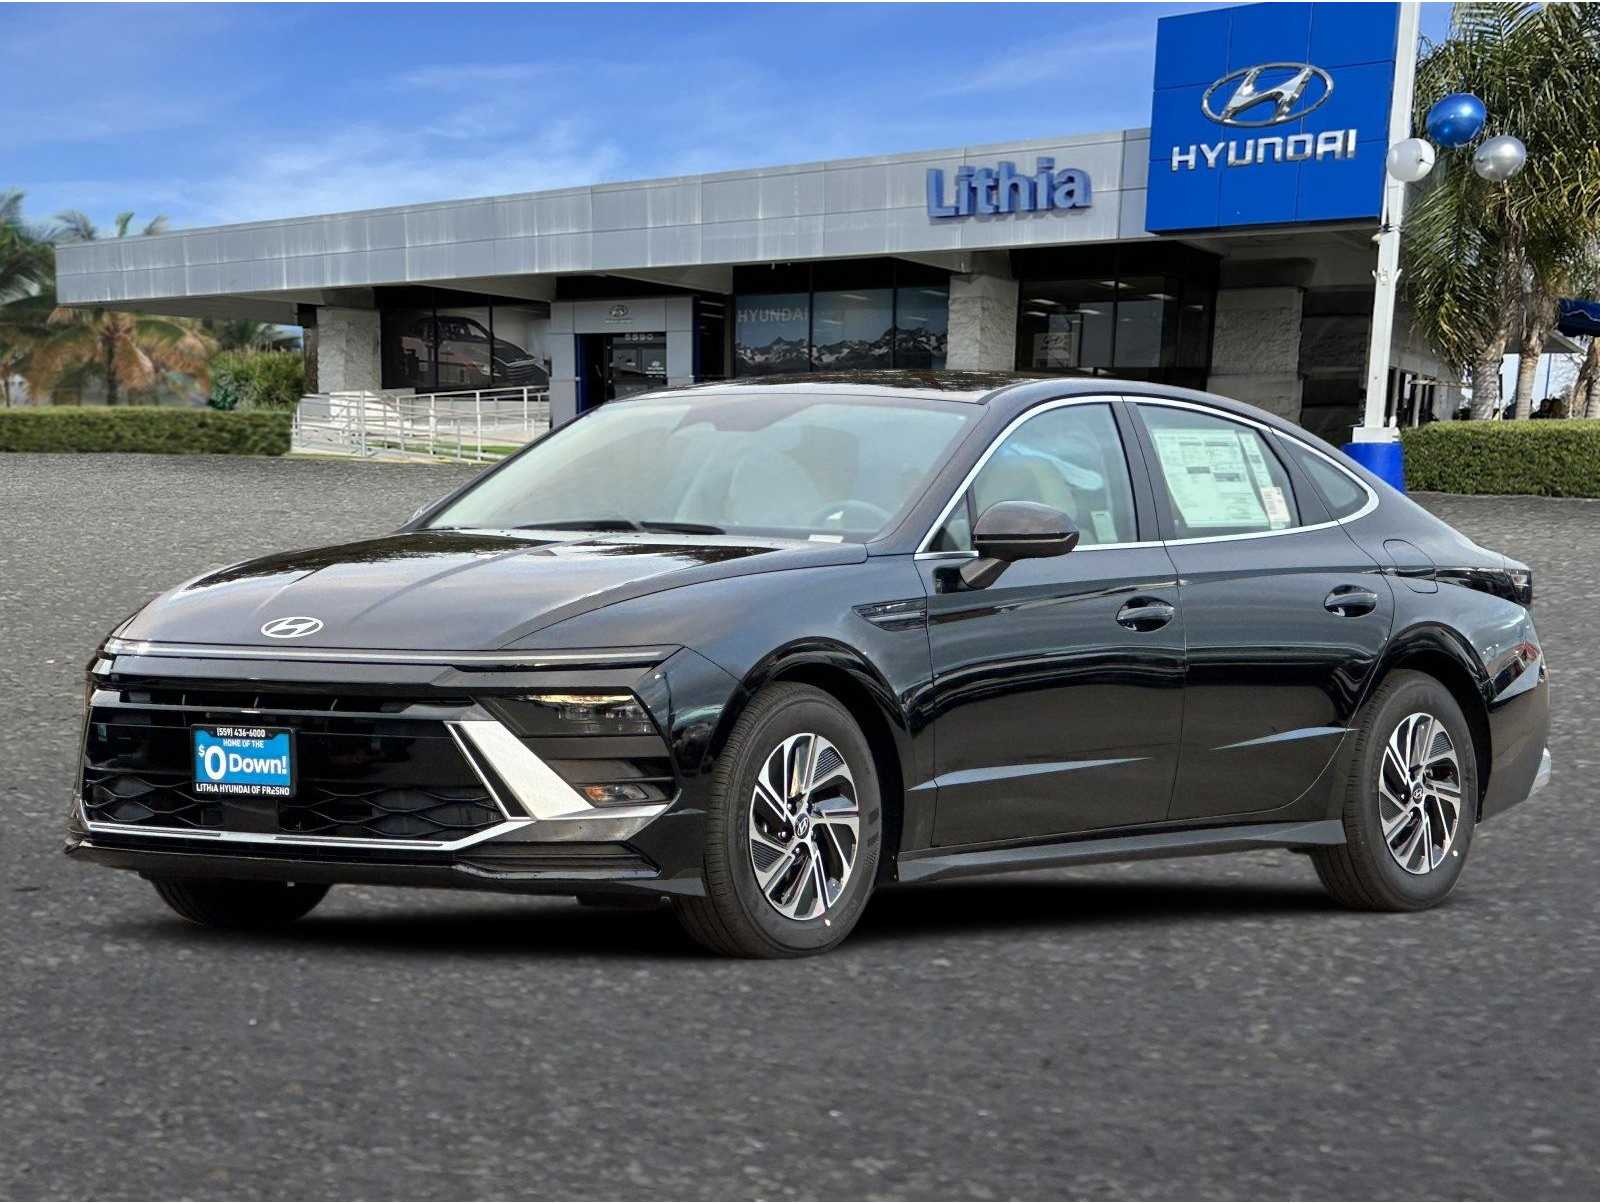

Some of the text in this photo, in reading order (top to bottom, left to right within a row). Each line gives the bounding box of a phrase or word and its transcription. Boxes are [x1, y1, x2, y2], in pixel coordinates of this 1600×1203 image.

[1171, 129, 1357, 172] HYUNDAI
[926, 156, 1092, 218] Lithia
[737, 307, 809, 321] HYUNDAI
[216, 727, 266, 738] (559) 436-6000
[223, 739, 265, 749] HOME OF THE
[228, 753, 288, 775] Down!
[219, 784, 251, 794] HYUNDAI
[251, 785, 261, 794] OF
